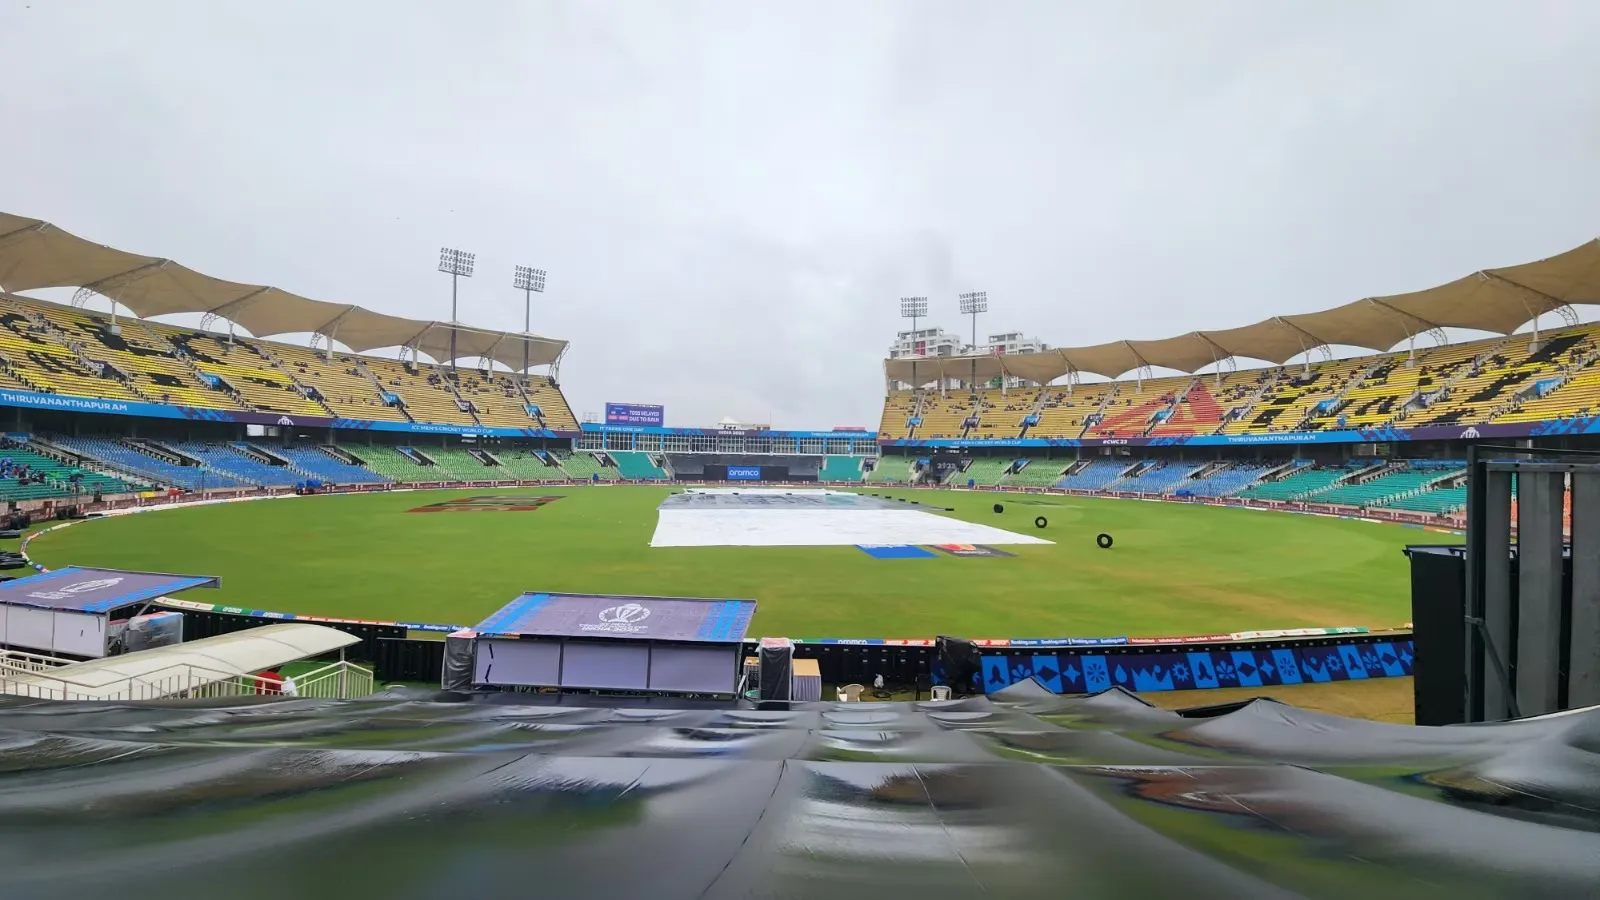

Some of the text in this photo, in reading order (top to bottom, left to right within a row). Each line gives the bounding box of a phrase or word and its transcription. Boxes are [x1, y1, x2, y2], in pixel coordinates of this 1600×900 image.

[1, 393, 128, 411] THIRUVANANTHAPURAM
[1228, 435, 1316, 443] THIRUVANANTHAPURAM
[729, 468, 759, 476] aramco
